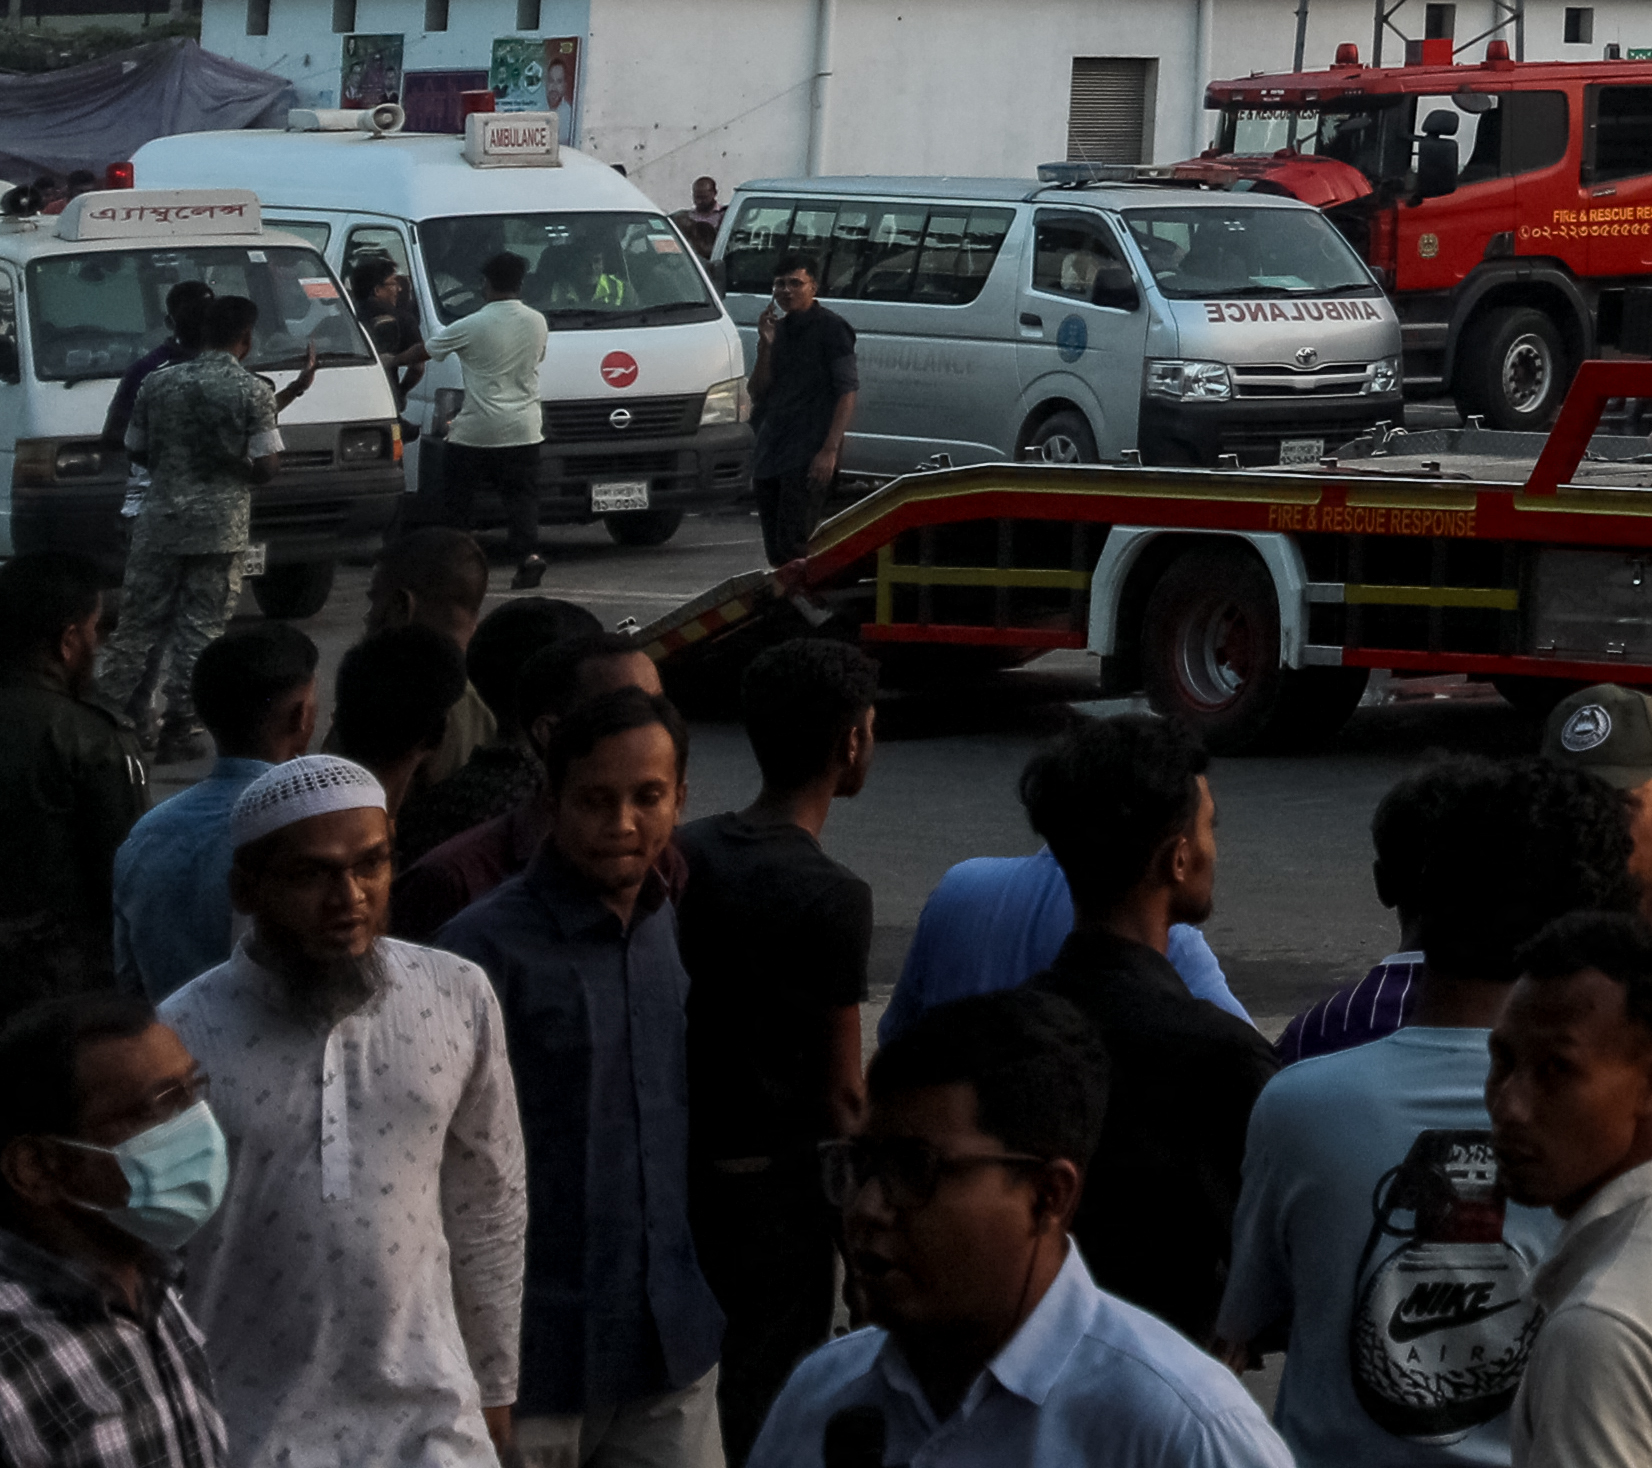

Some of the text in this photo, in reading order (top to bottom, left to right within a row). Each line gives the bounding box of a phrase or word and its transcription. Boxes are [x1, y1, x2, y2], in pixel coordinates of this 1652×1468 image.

[489, 127, 547, 148] AMBULANCE
[1553, 209, 1577, 224] FIRE
[1579, 209, 1588, 222] &
[1590, 207, 1634, 222] RESCUE
[1268, 504, 1477, 536] FIRE & RESCUE RESPONSE
[1402, 1281, 1496, 1316] NIKE
[1407, 1344, 1484, 1363] AIR
